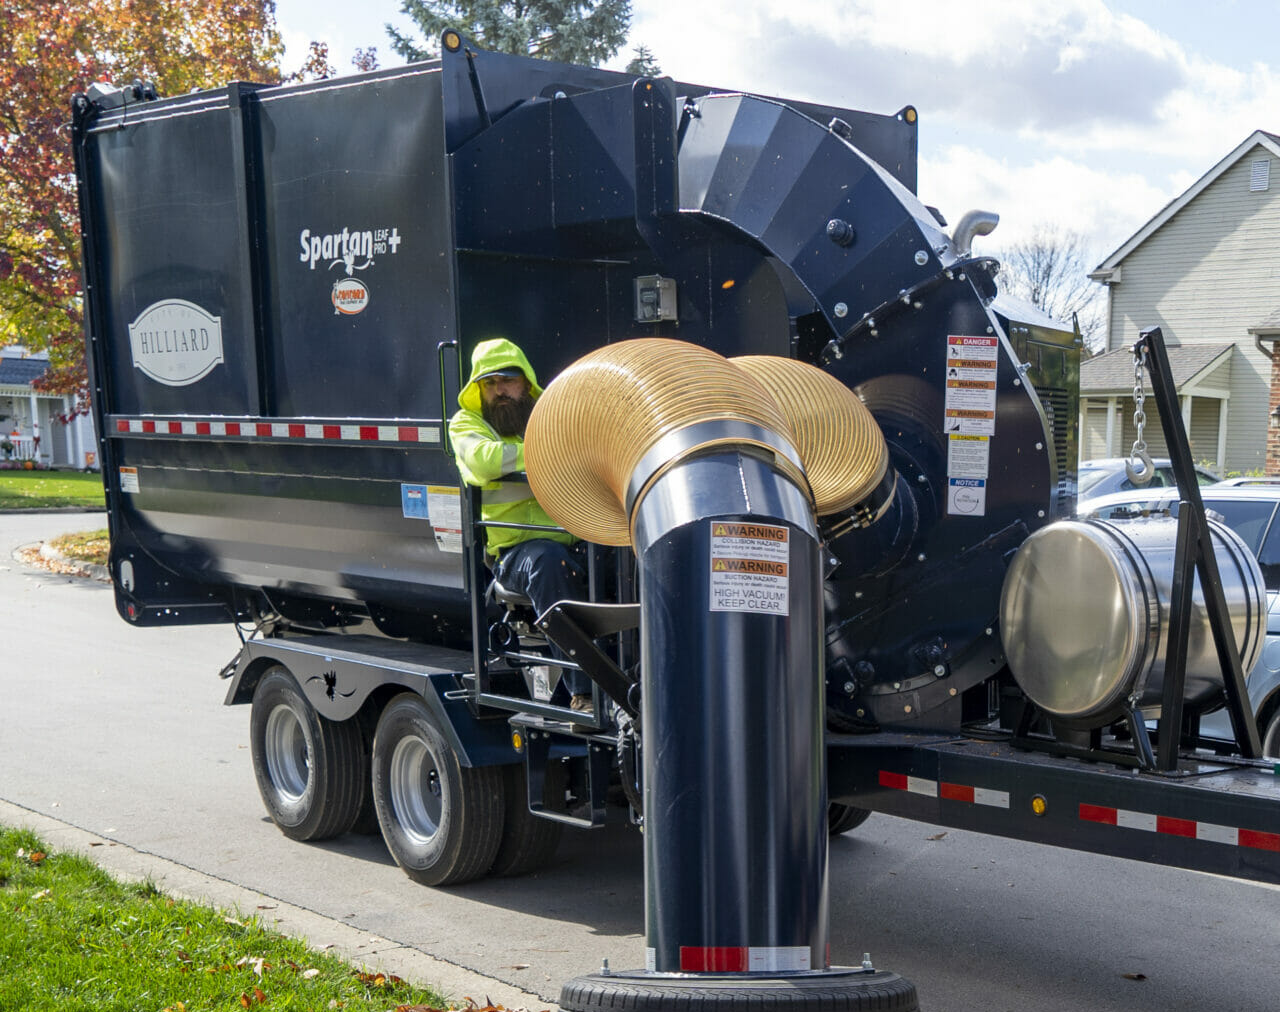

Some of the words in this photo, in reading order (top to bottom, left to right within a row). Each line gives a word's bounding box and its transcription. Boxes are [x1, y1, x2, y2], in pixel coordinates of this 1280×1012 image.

[374, 229, 389, 242] LEAF
[300, 226, 373, 270] Spartan
[374, 242, 387, 254] PRO
[140, 328, 209, 354] HILLIARD
[963, 338, 991, 346] DANGER
[957, 410, 988, 418] WARNING
[727, 525, 784, 540] WARNING
[757, 540, 781, 548] HAZARD
[727, 560, 784, 575] WARNING
[753, 575, 777, 583] HAZARD
[714, 588, 740, 598] HIGH
[718, 599, 745, 608] KEEP
